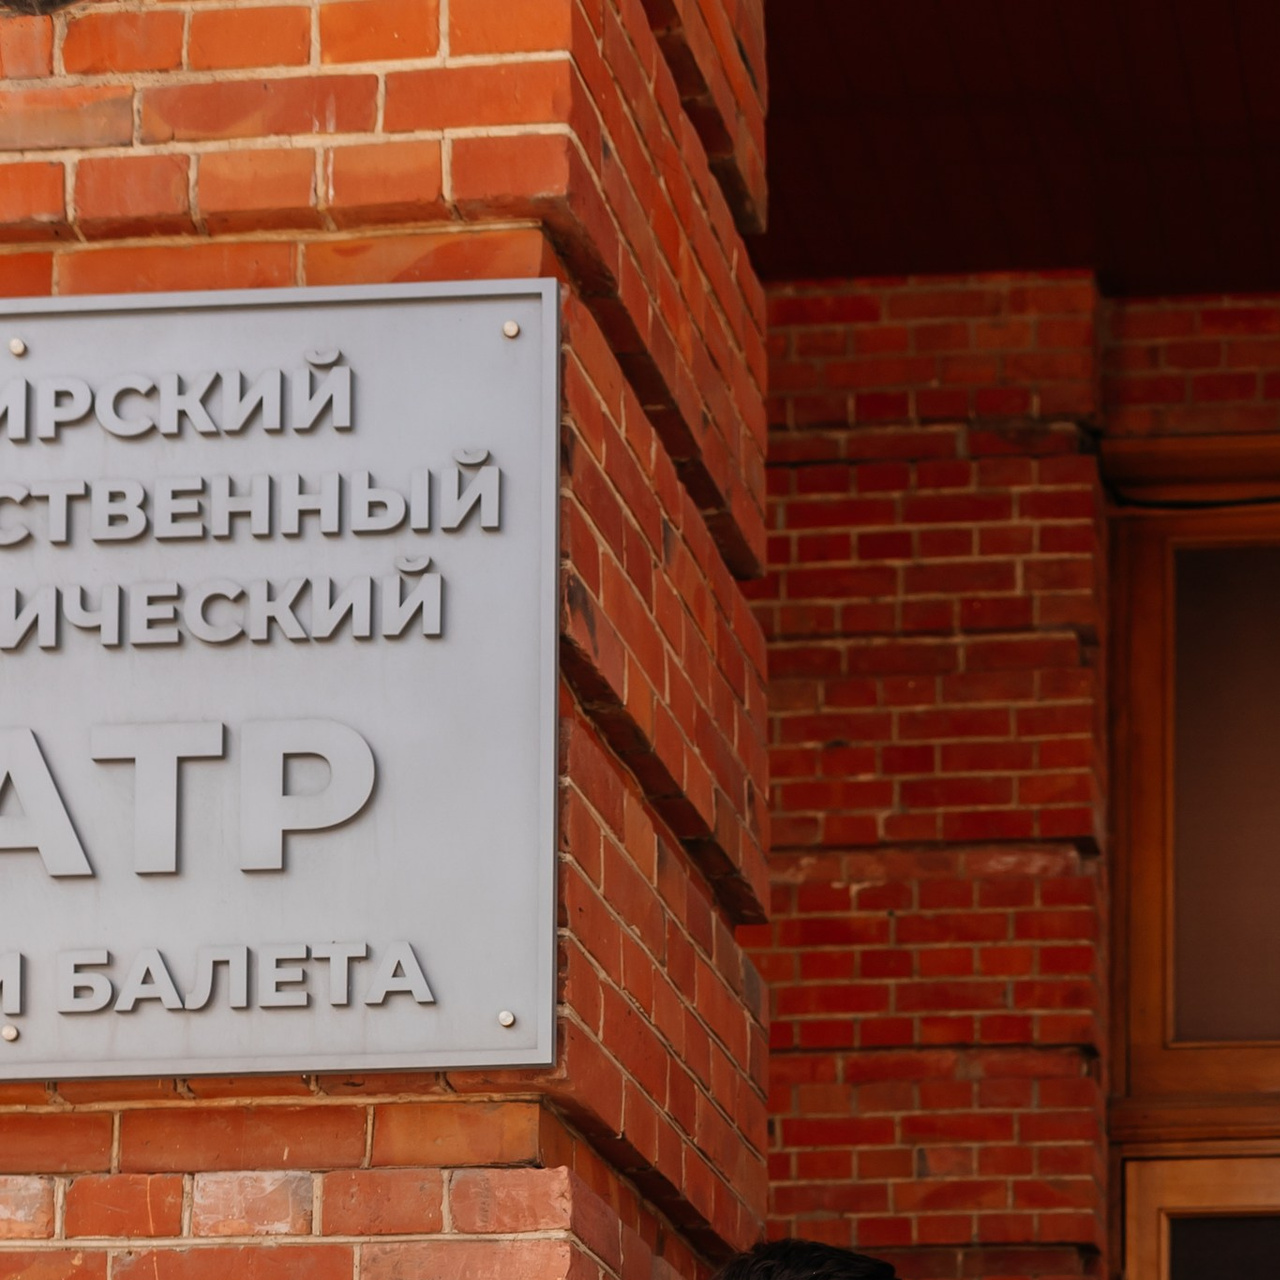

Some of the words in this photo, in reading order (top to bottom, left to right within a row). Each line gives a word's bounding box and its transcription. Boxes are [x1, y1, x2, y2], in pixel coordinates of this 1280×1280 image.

[0, 556, 443, 650] ИЧЕСКИЙ
[0, 717, 377, 879] АТР
[57, 940, 436, 1015] БАЛЕТА
